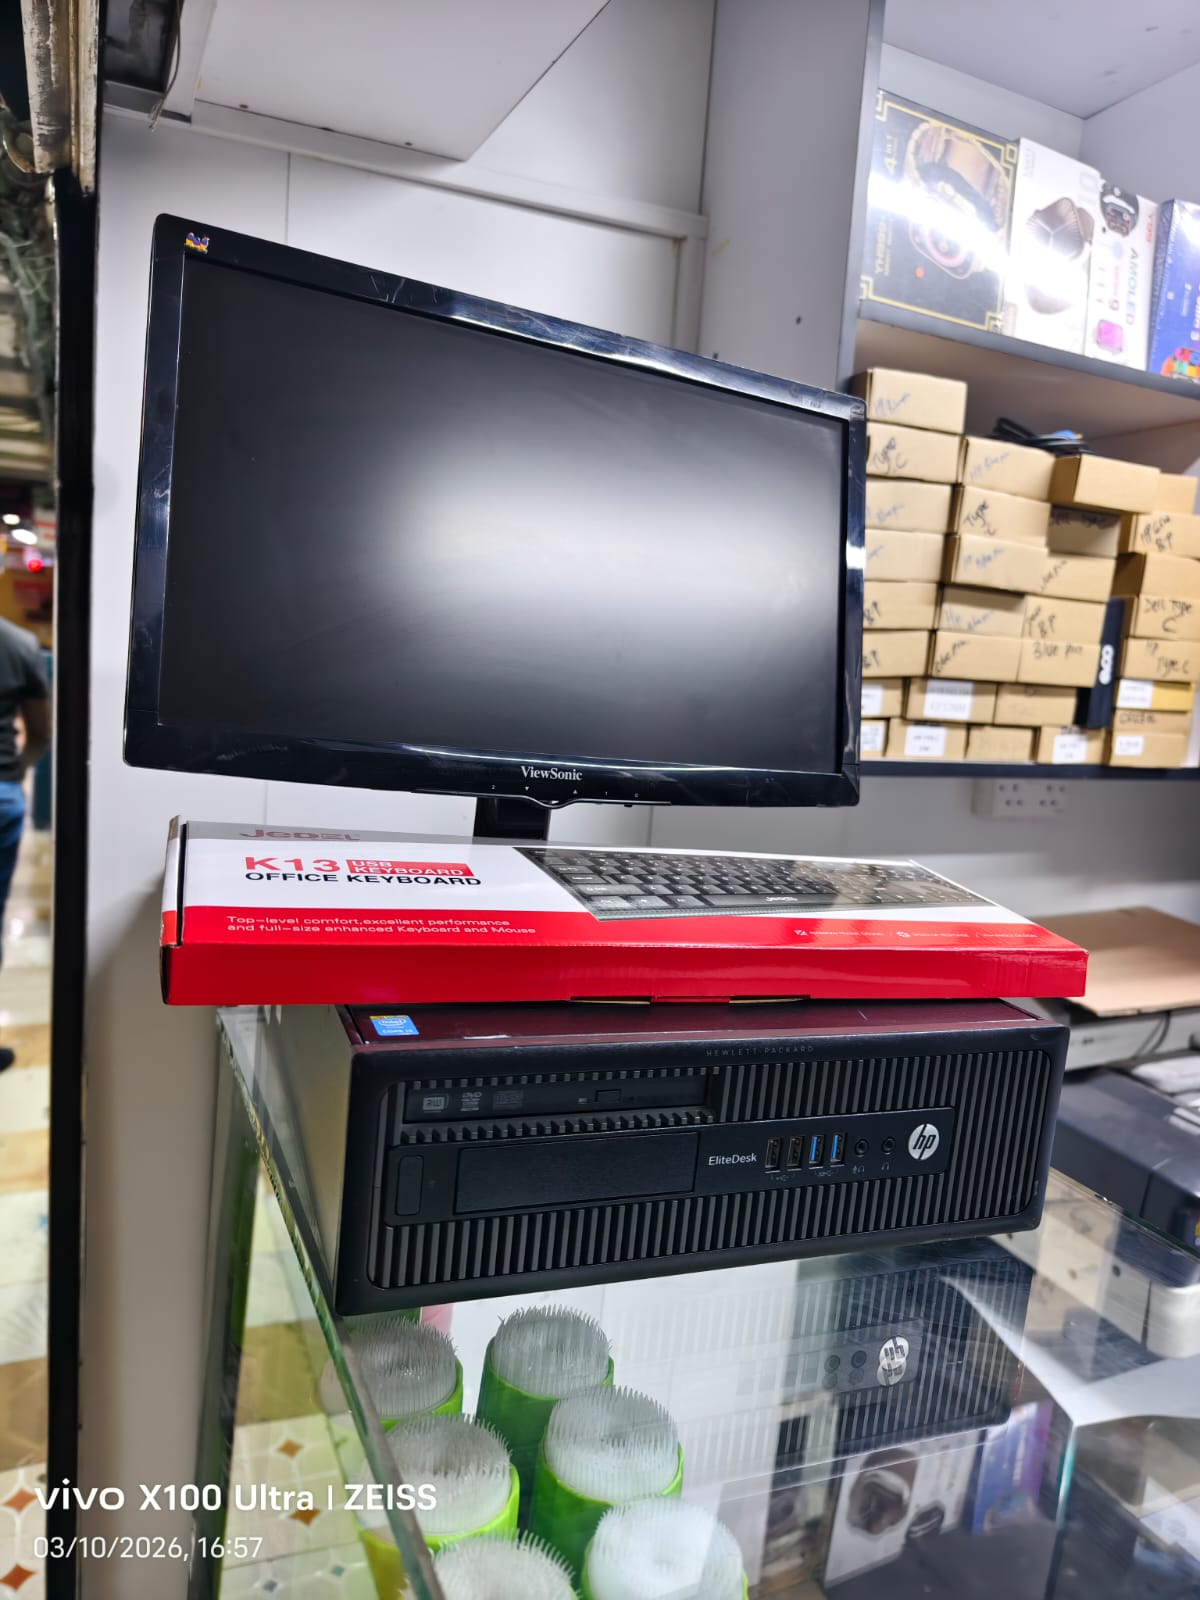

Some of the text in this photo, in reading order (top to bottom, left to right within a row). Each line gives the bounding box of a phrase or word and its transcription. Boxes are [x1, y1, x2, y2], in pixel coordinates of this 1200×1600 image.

[1125, 247, 1140, 326] AMOLED
[520, 765, 583, 781] ViewSonic
[245, 856, 393, 873] K13 USB
[354, 866, 464, 877] KEYBOARD
[245, 872, 482, 886] OFFICE KEYBOARD
[226, 915, 300, 925] Top-level
[427, 918, 511, 927] performance
[227, 924, 255, 932] and
[259, 924, 321, 933] full-size
[324, 925, 394, 933] enhanced
[397, 926, 461, 934] Keyboard
[491, 926, 537, 934] Mouse
[910, 1123, 938, 1160] hp
[708, 1152, 758, 1166] EliteDesk
